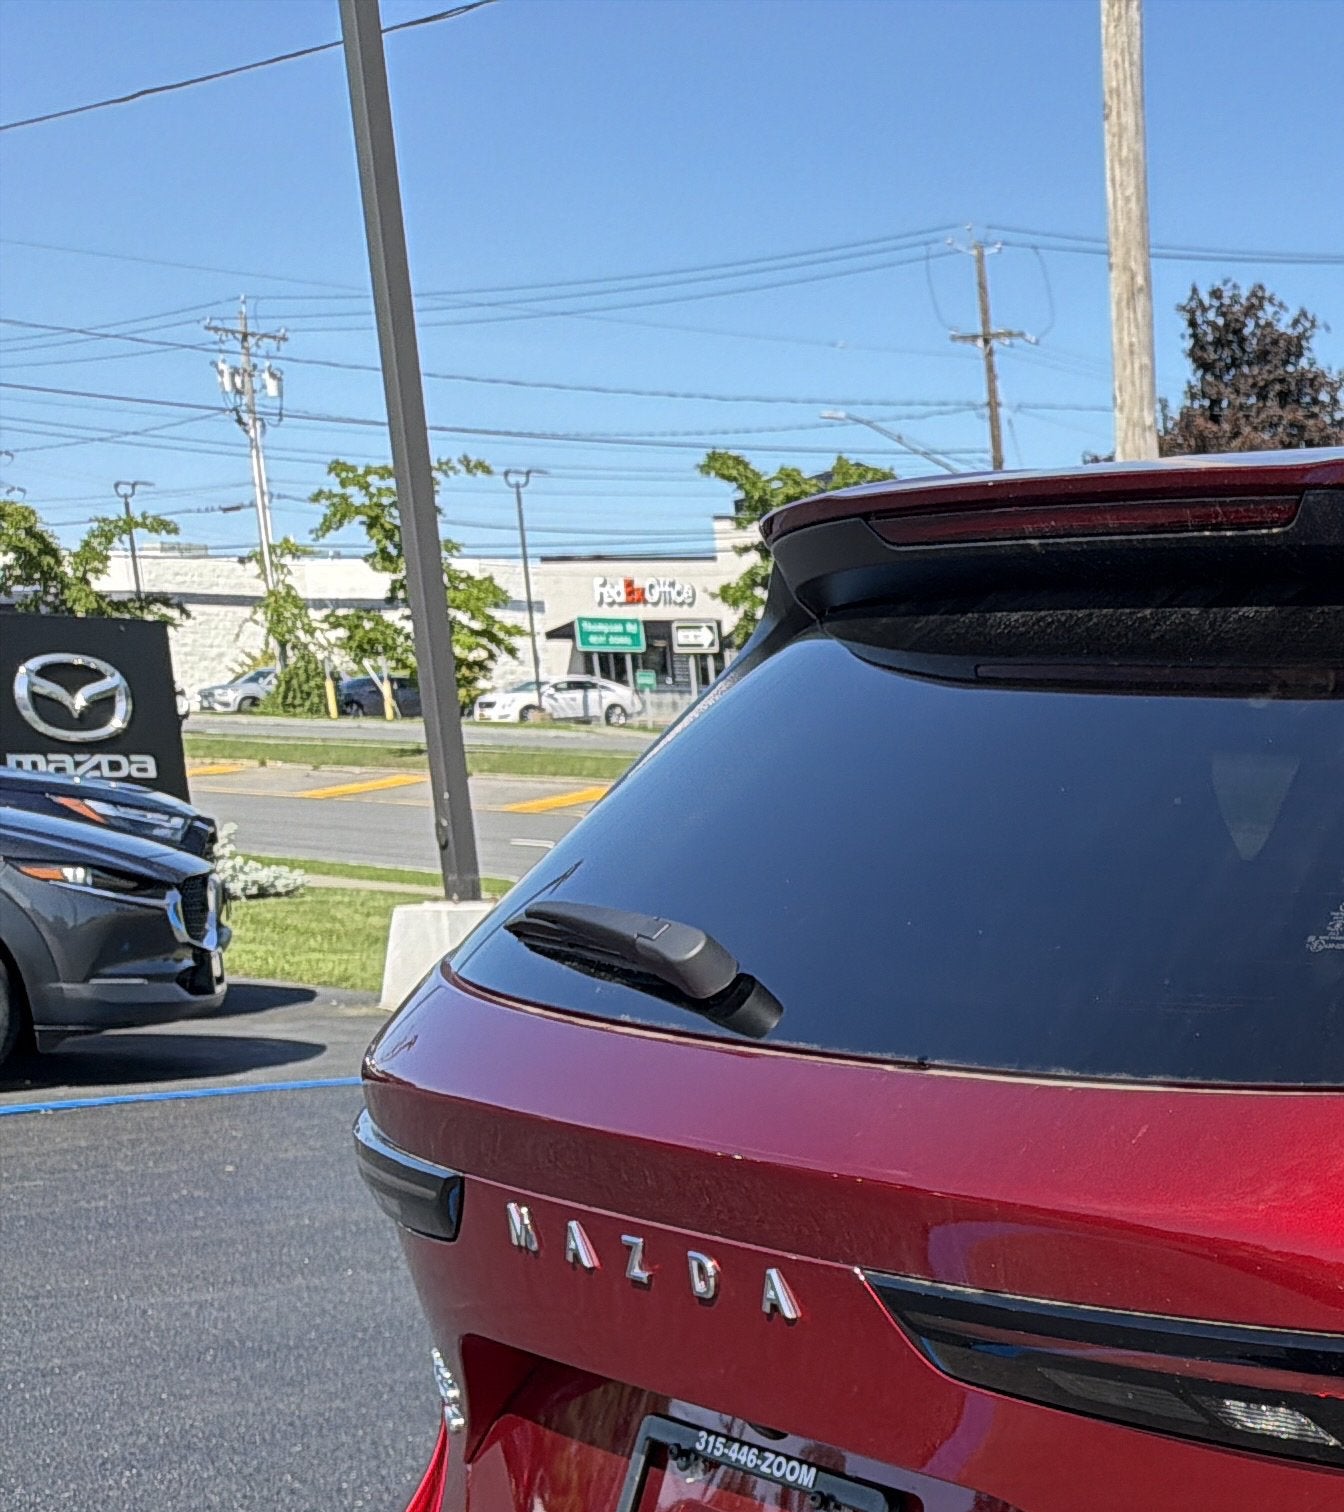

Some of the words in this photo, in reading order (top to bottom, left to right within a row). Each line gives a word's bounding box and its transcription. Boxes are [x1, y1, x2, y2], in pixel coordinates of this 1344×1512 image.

[593, 576, 646, 606] FedEx
[645, 576, 695, 607] Office
[506, 1202, 802, 1320] MAZDA
[695, 1430, 818, 1489] 315-446-ZOOM
